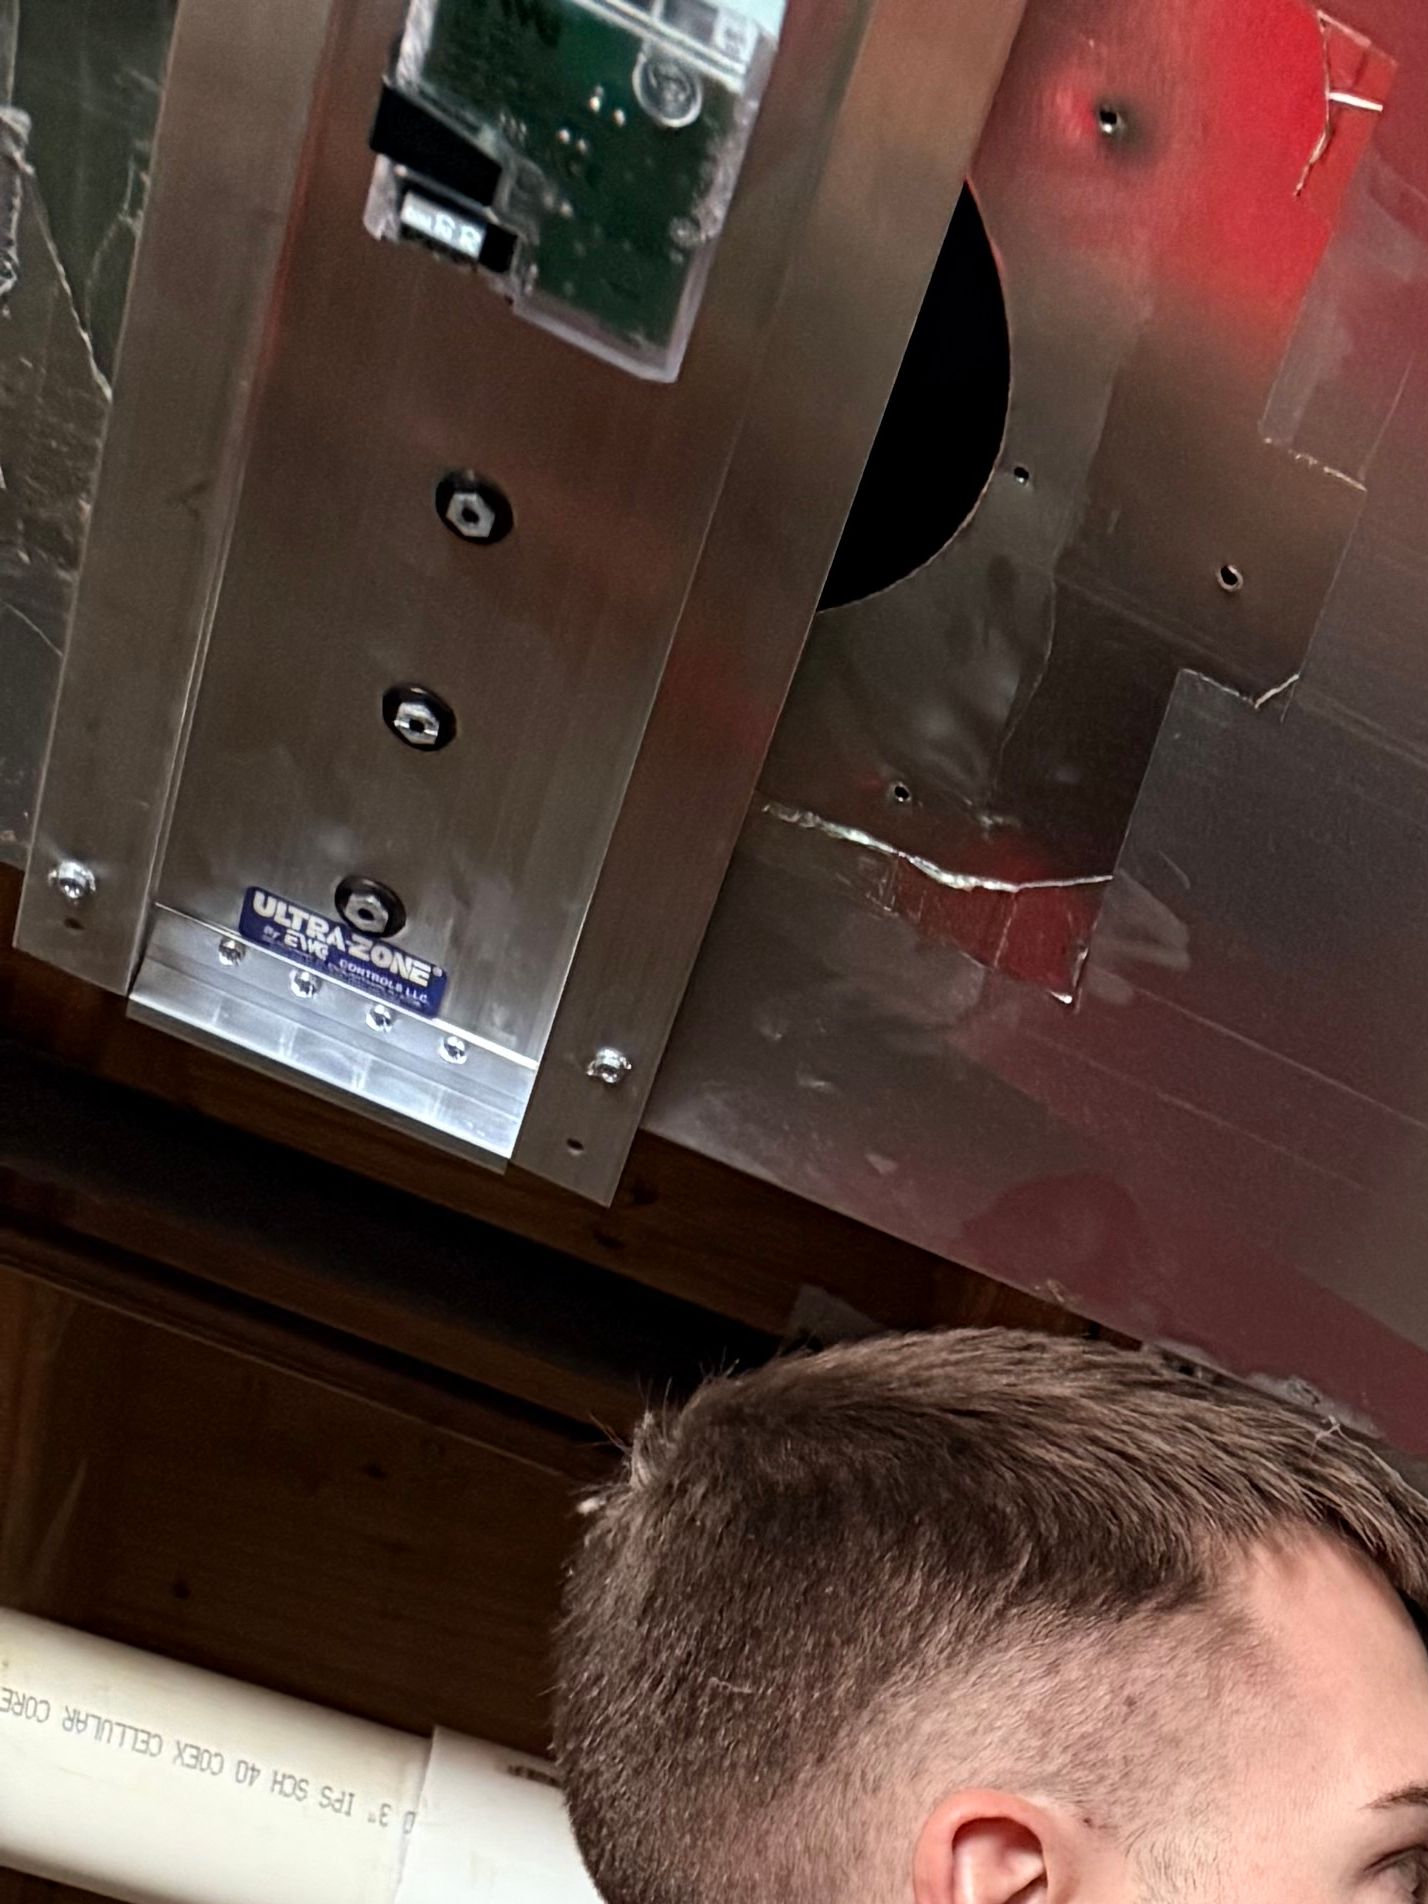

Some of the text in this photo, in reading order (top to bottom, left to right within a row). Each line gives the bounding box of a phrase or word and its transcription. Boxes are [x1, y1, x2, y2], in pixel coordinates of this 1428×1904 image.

[339, 958, 403, 993] CONTROLS
[0, 1687, 51, 1724] CORE
[62, 1706, 163, 1757] CELLULAR
[172, 1740, 224, 1776] COEX
[235, 1758, 261, 1787] 40
[272, 1769, 309, 1803] SCH
[319, 1785, 355, 1818] IPS
